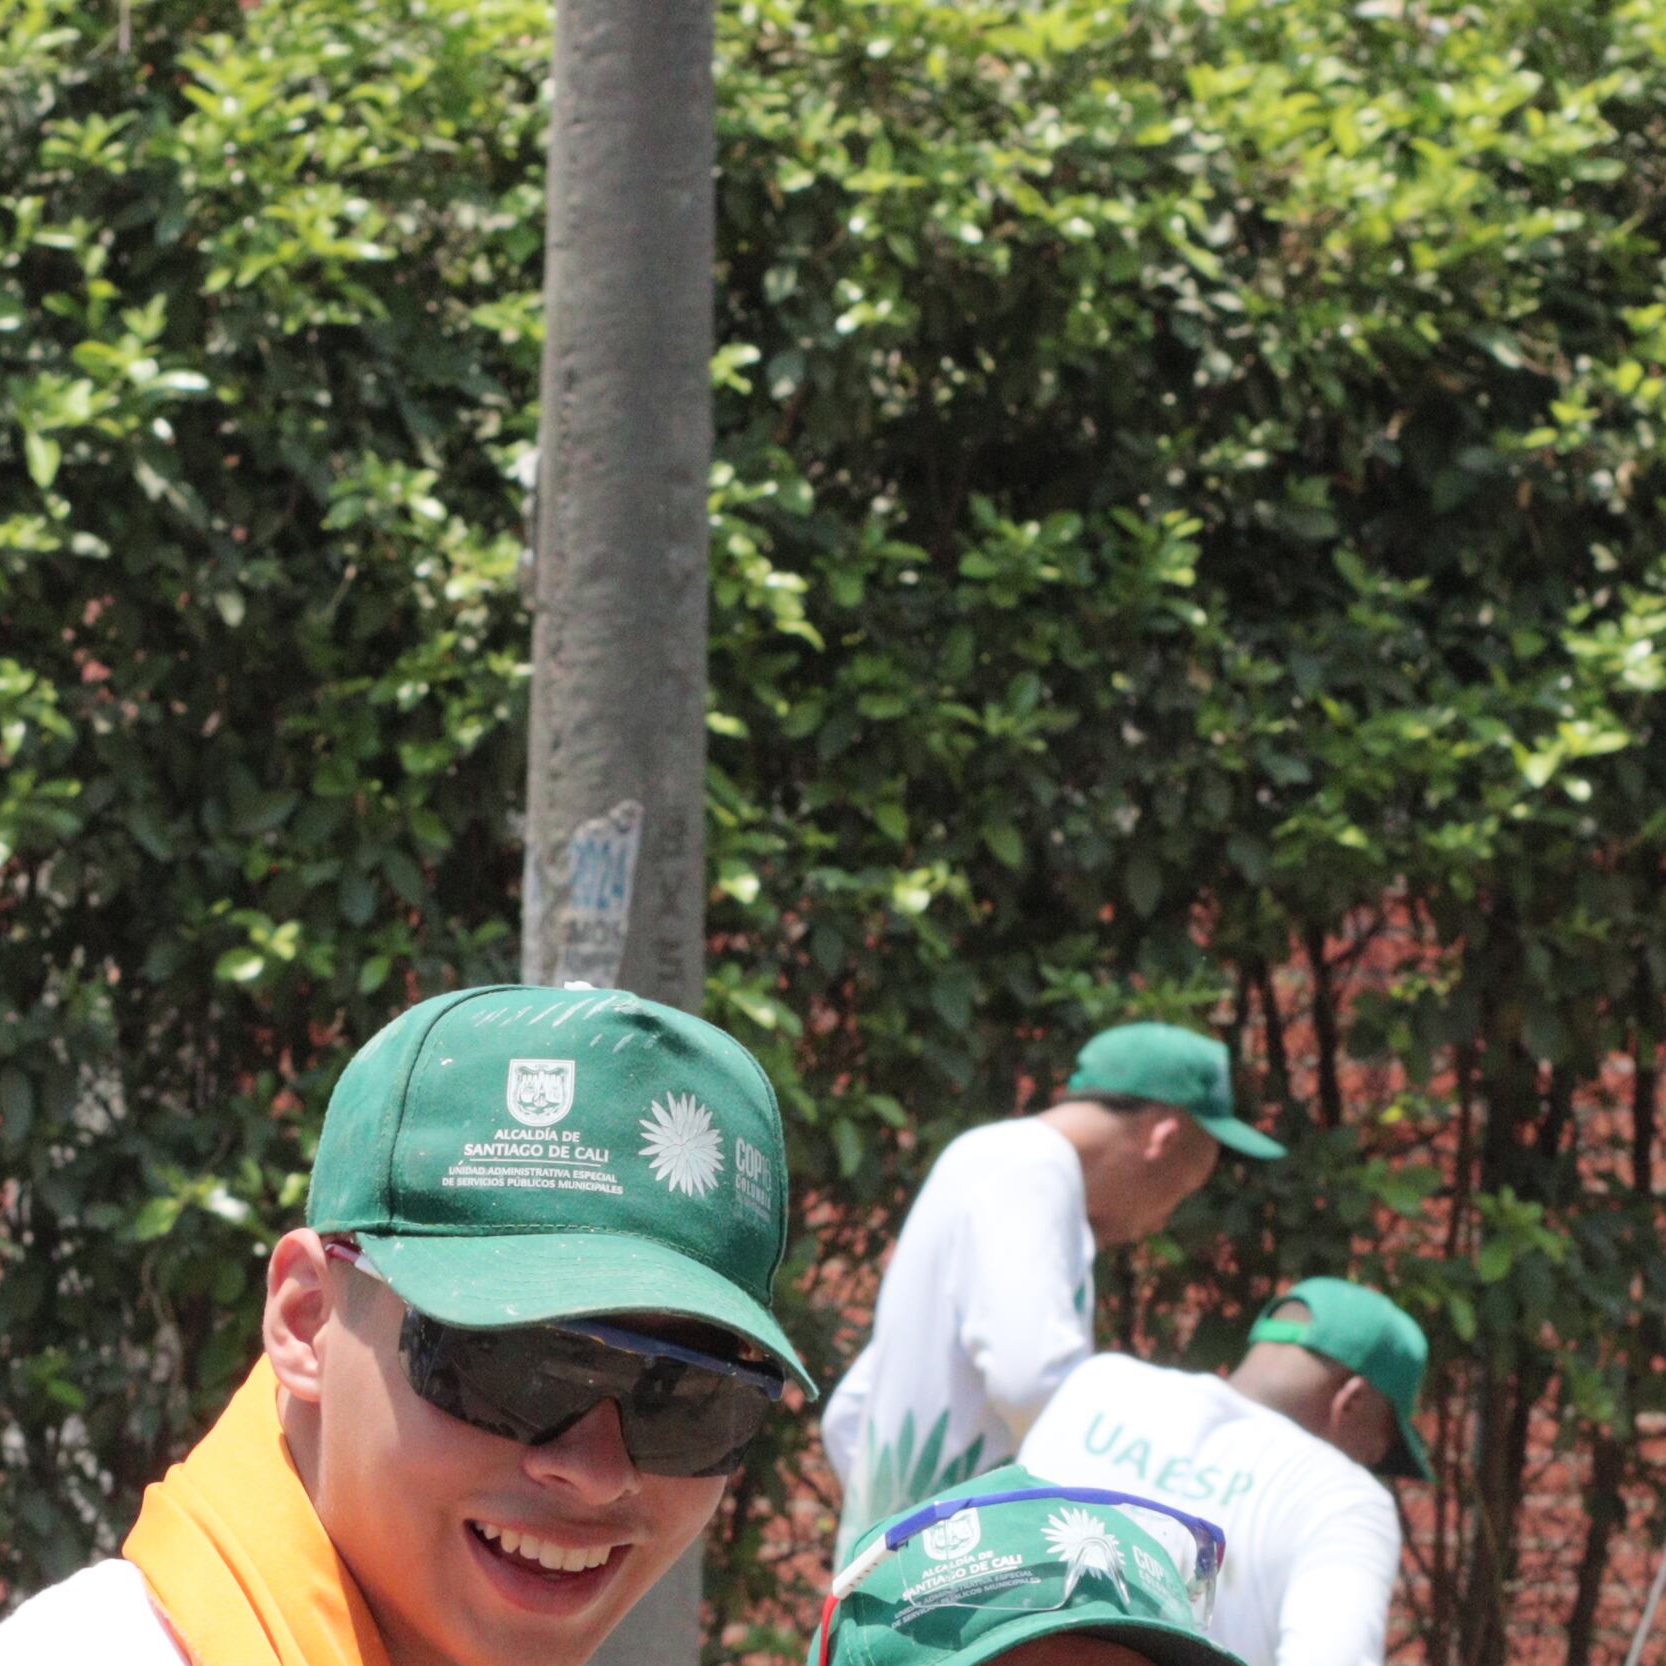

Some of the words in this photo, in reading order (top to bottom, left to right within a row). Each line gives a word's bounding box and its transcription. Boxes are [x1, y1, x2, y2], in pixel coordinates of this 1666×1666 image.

[494, 1127, 558, 1141] ALCALDÍA
[562, 1131, 581, 1142] DE
[463, 1143, 543, 1157] SANTIAGO
[548, 1145, 570, 1159] DE
[574, 1147, 609, 1163] CALI
[448, 1166, 485, 1175] UNIDAD
[486, 1166, 571, 1179] ADMINISTRATIVA
[572, 1169, 618, 1183] ESPECIAL
[442, 1177, 454, 1186] DE
[456, 1177, 505, 1187] SERVICIOS
[507, 1176, 555, 1189] PÚBLICOS
[558, 1179, 624, 1195] MUNICIPALES
[1084, 1411, 1254, 1506] UAESP
[921, 1555, 976, 1579] ALCALDÍA
[978, 1550, 995, 1560] DE
[970, 1563, 990, 1575] DE
[992, 1554, 1023, 1568] CALI
